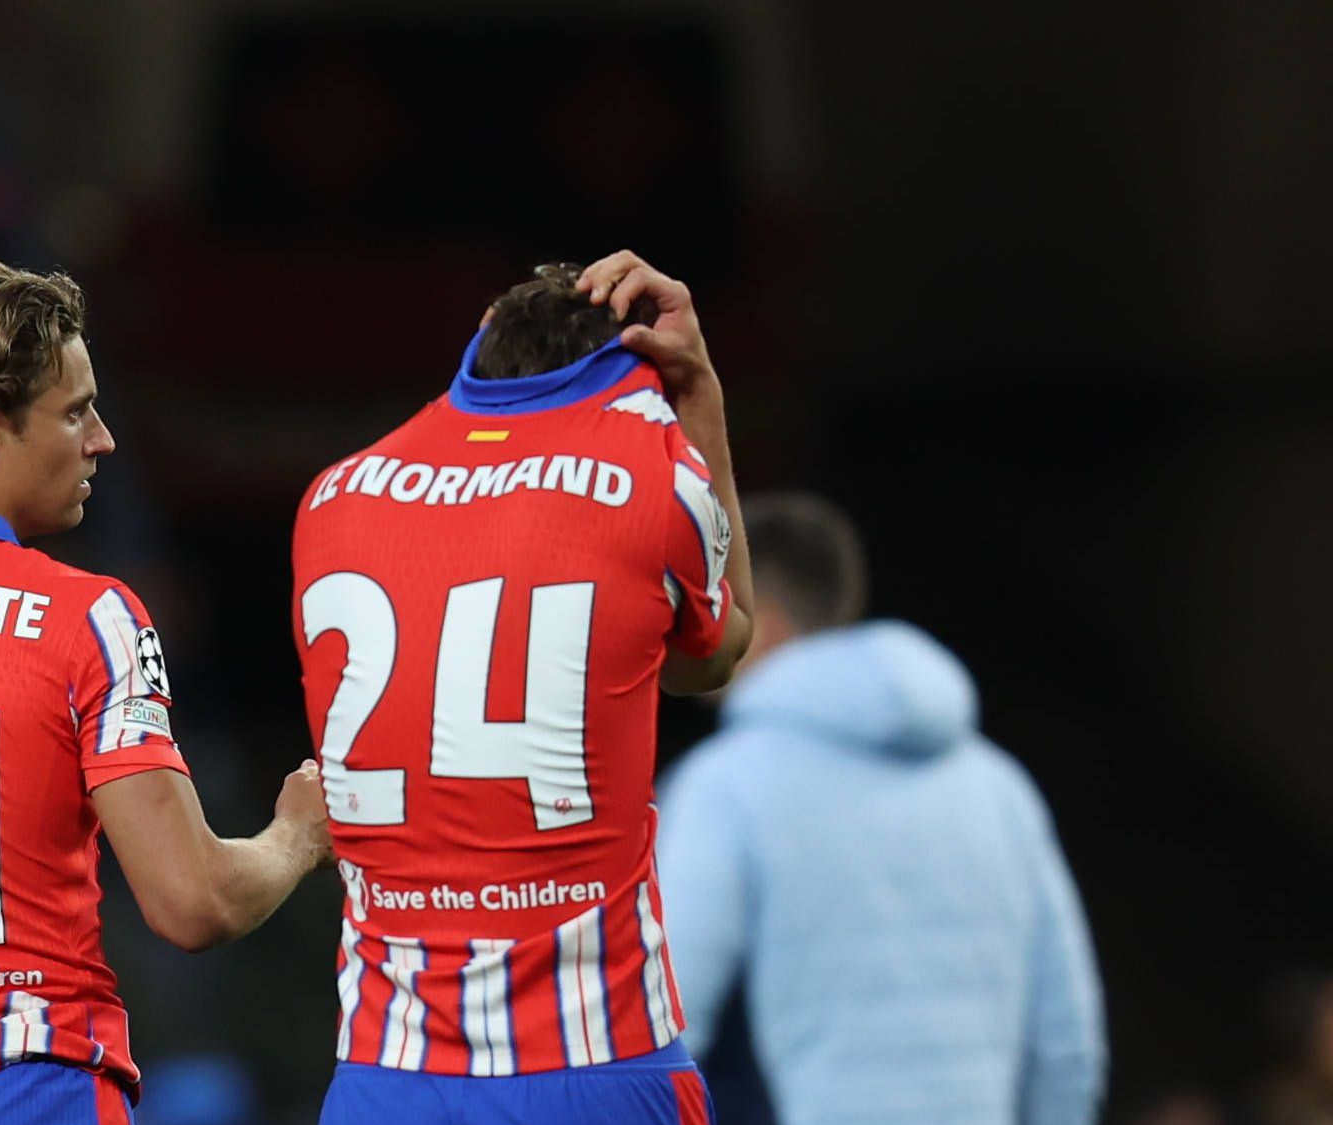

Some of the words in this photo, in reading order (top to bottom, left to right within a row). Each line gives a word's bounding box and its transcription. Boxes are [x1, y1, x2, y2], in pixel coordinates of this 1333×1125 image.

[345, 454, 633, 508] NORMAND
[301, 570, 596, 832] 24
[370, 882, 426, 911] Save
[430, 884, 476, 910] the
[479, 879, 606, 911] Children
